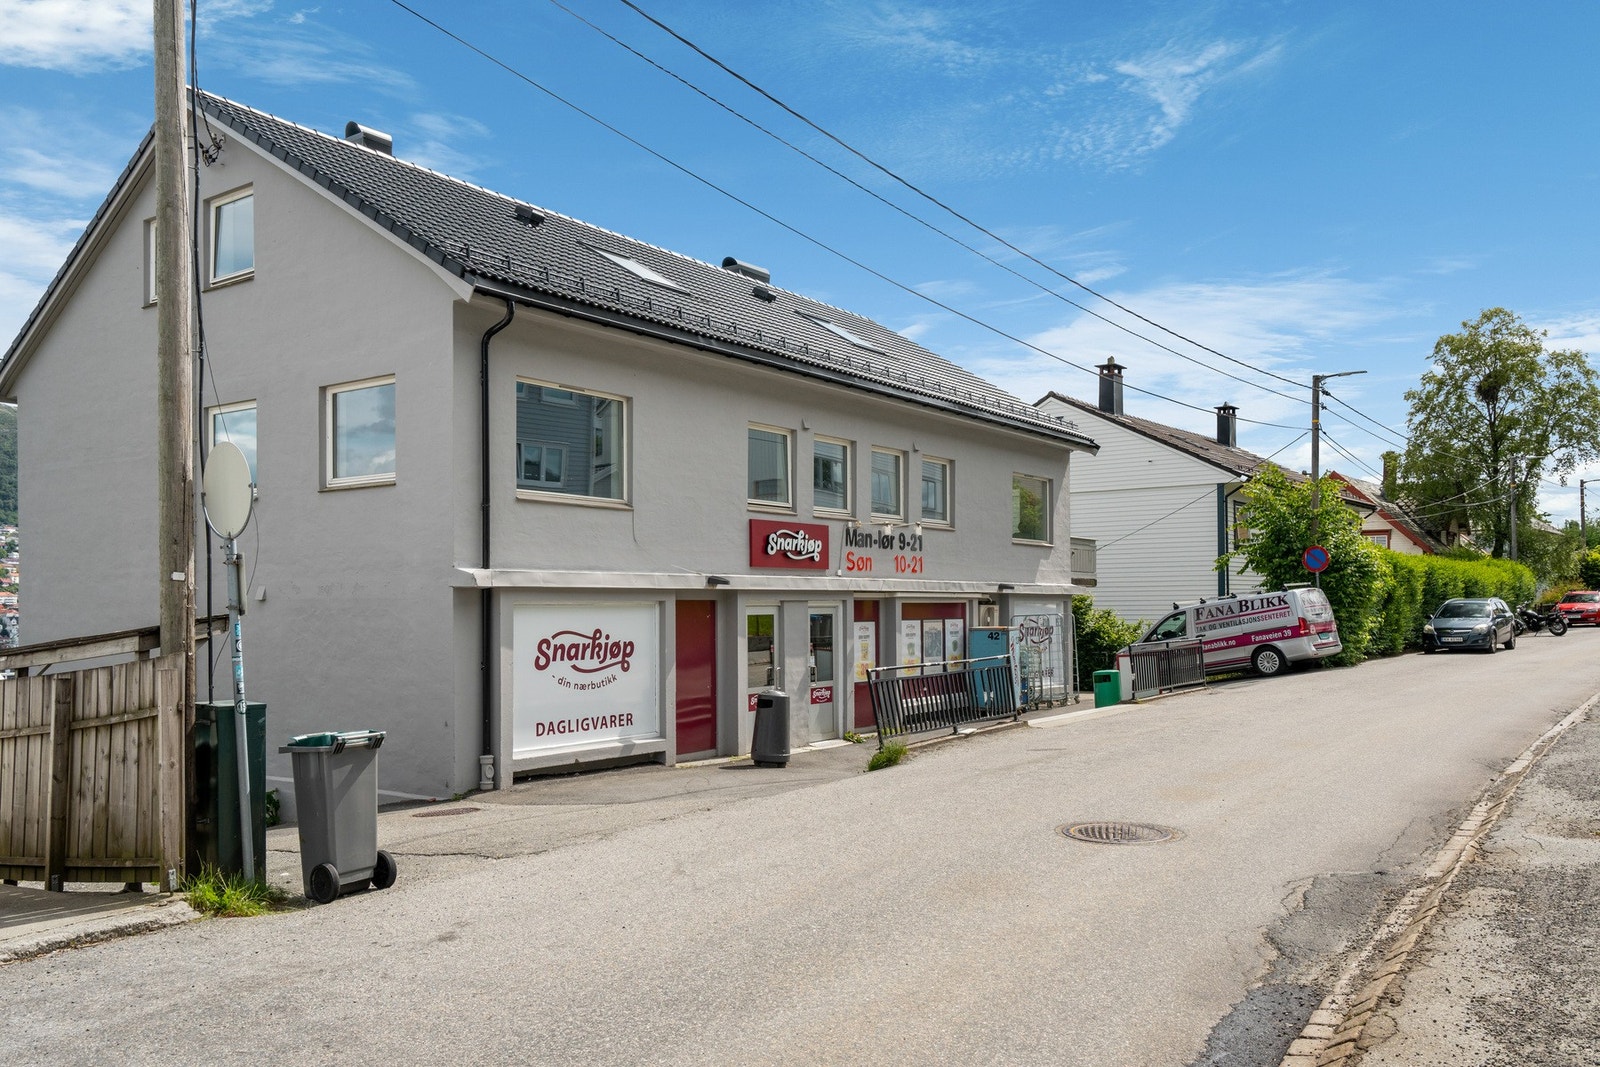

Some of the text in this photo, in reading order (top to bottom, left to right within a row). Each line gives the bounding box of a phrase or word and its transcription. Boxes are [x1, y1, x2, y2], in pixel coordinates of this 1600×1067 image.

[767, 529, 822, 562] Snarkjøp
[846, 551, 872, 571] Søn
[1194, 604, 1237, 621] FANA
[1238, 594, 1289, 613] BLIKK
[1208, 622, 1217, 630] OG
[1219, 610, 1291, 629] VENTILASJONSSENTERET
[987, 631, 1000, 641] 42
[1251, 629, 1292, 642] Fanaveien 39
[534, 628, 635, 673] Snarkjøp
[557, 676, 571, 689] din
[573, 673, 618, 691] nærbutikk
[536, 712, 634, 737] DAGLIGVARER
